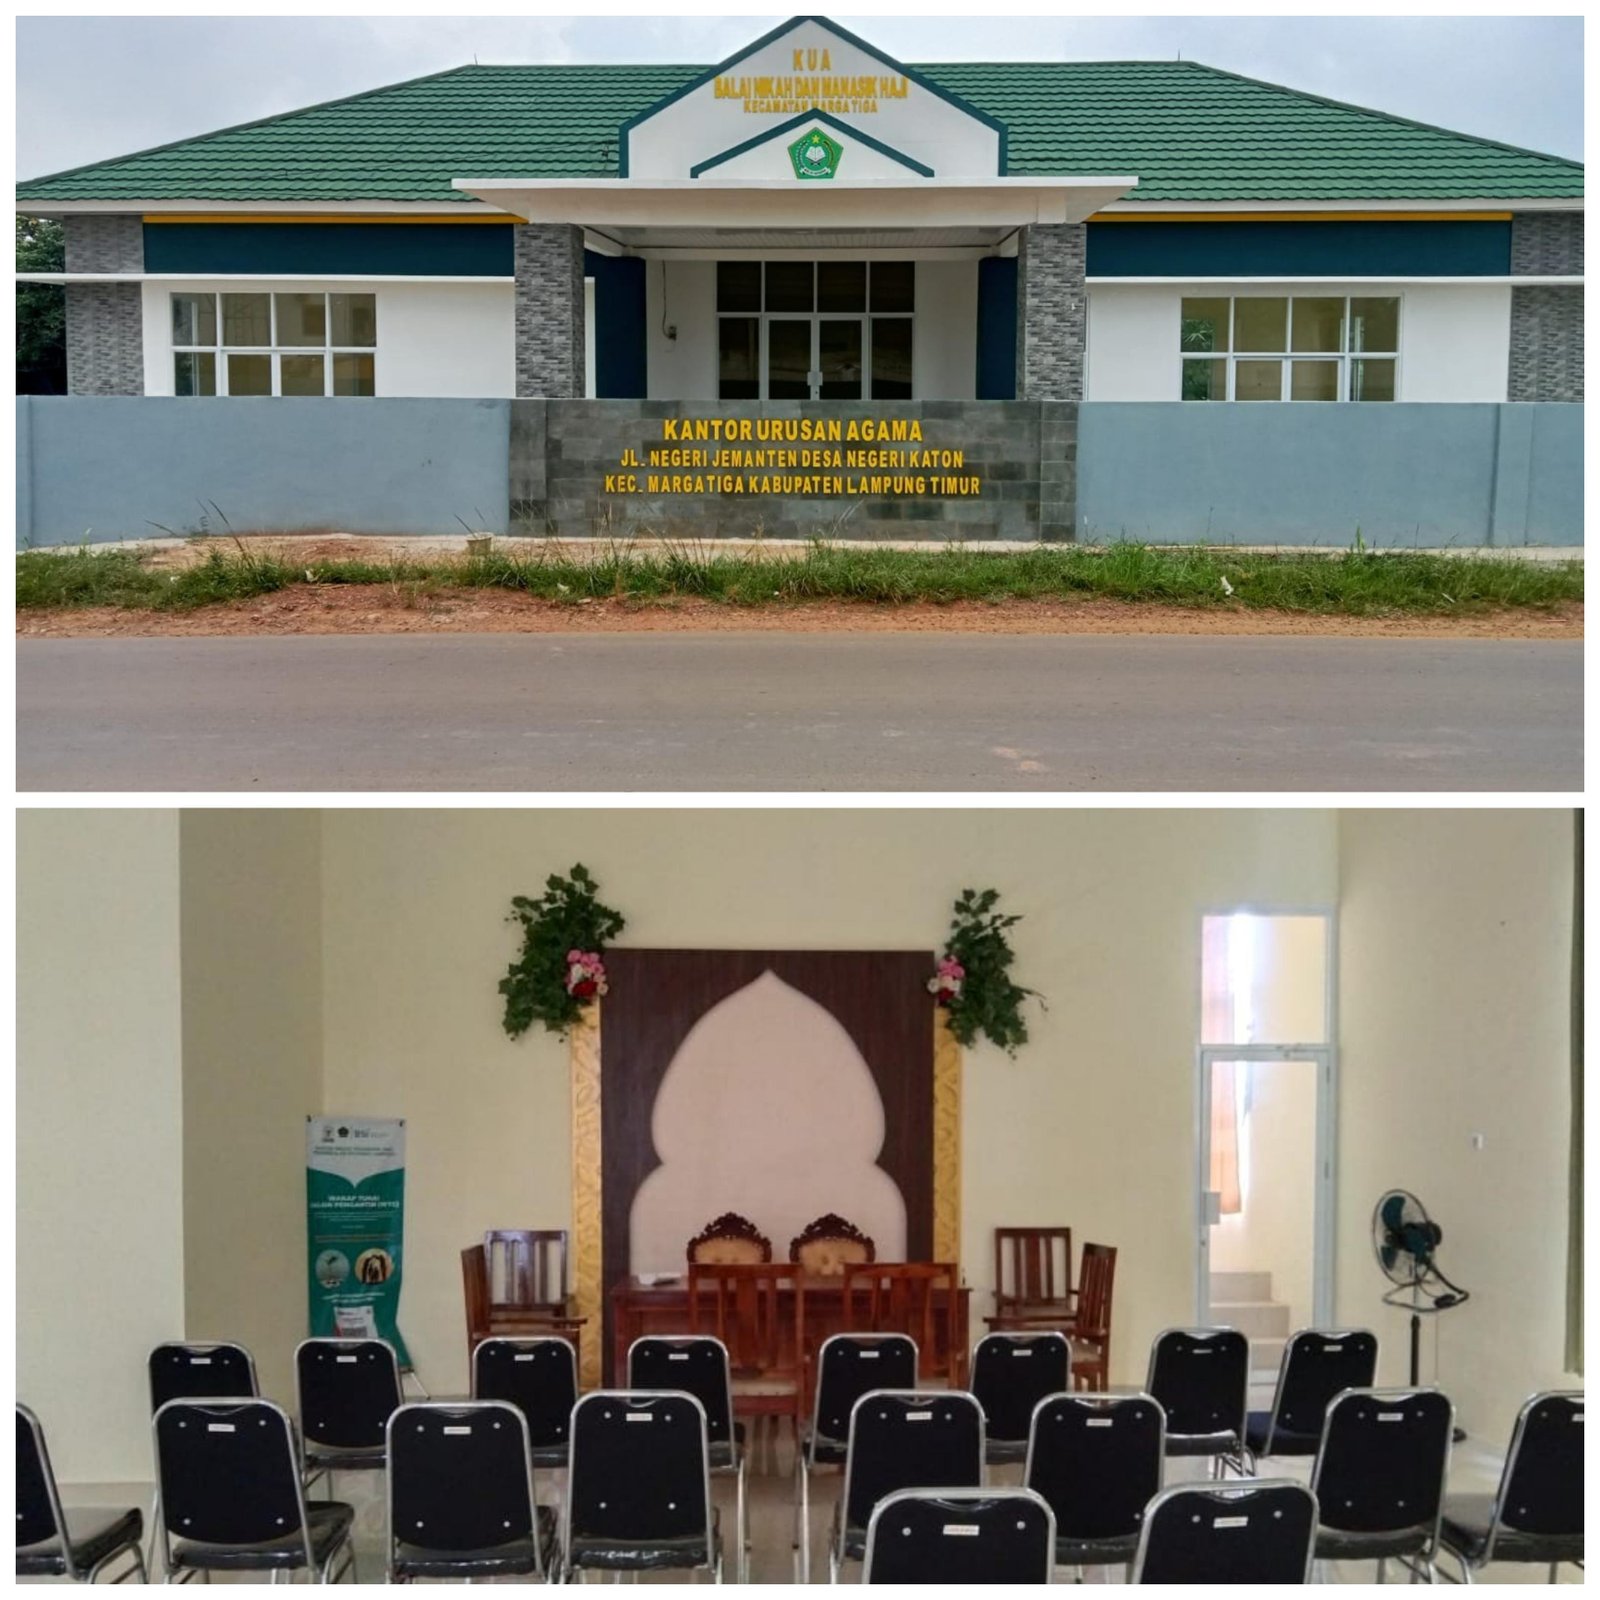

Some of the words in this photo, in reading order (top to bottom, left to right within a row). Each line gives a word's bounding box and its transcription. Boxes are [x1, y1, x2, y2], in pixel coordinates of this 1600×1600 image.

[714, 76, 751, 99] BALAI
[754, 76, 792, 99] NIKAH
[795, 76, 820, 99] DAN
[822, 76, 877, 99] MANASIK
[880, 76, 909, 99] HAJI
[743, 99, 809, 112] KECAMATAN
[851, 99, 878, 112] TIGA
[663, 419, 752, 441] KANTOR
[756, 419, 841, 441] URUSAN
[846, 419, 923, 442] AGAMA
[650, 448, 708, 467] NEGERI
[712, 448, 798, 468] JEMANTEN
[801, 449, 843, 468] DESA
[846, 449, 906, 468] NEGERI
[908, 449, 964, 468] KATON
[605, 474, 644, 492] KEC.
[748, 475, 843, 494] KABUPATEN
[846, 475, 926, 494] LAMPUNG
[930, 476, 980, 495] TIMUR
